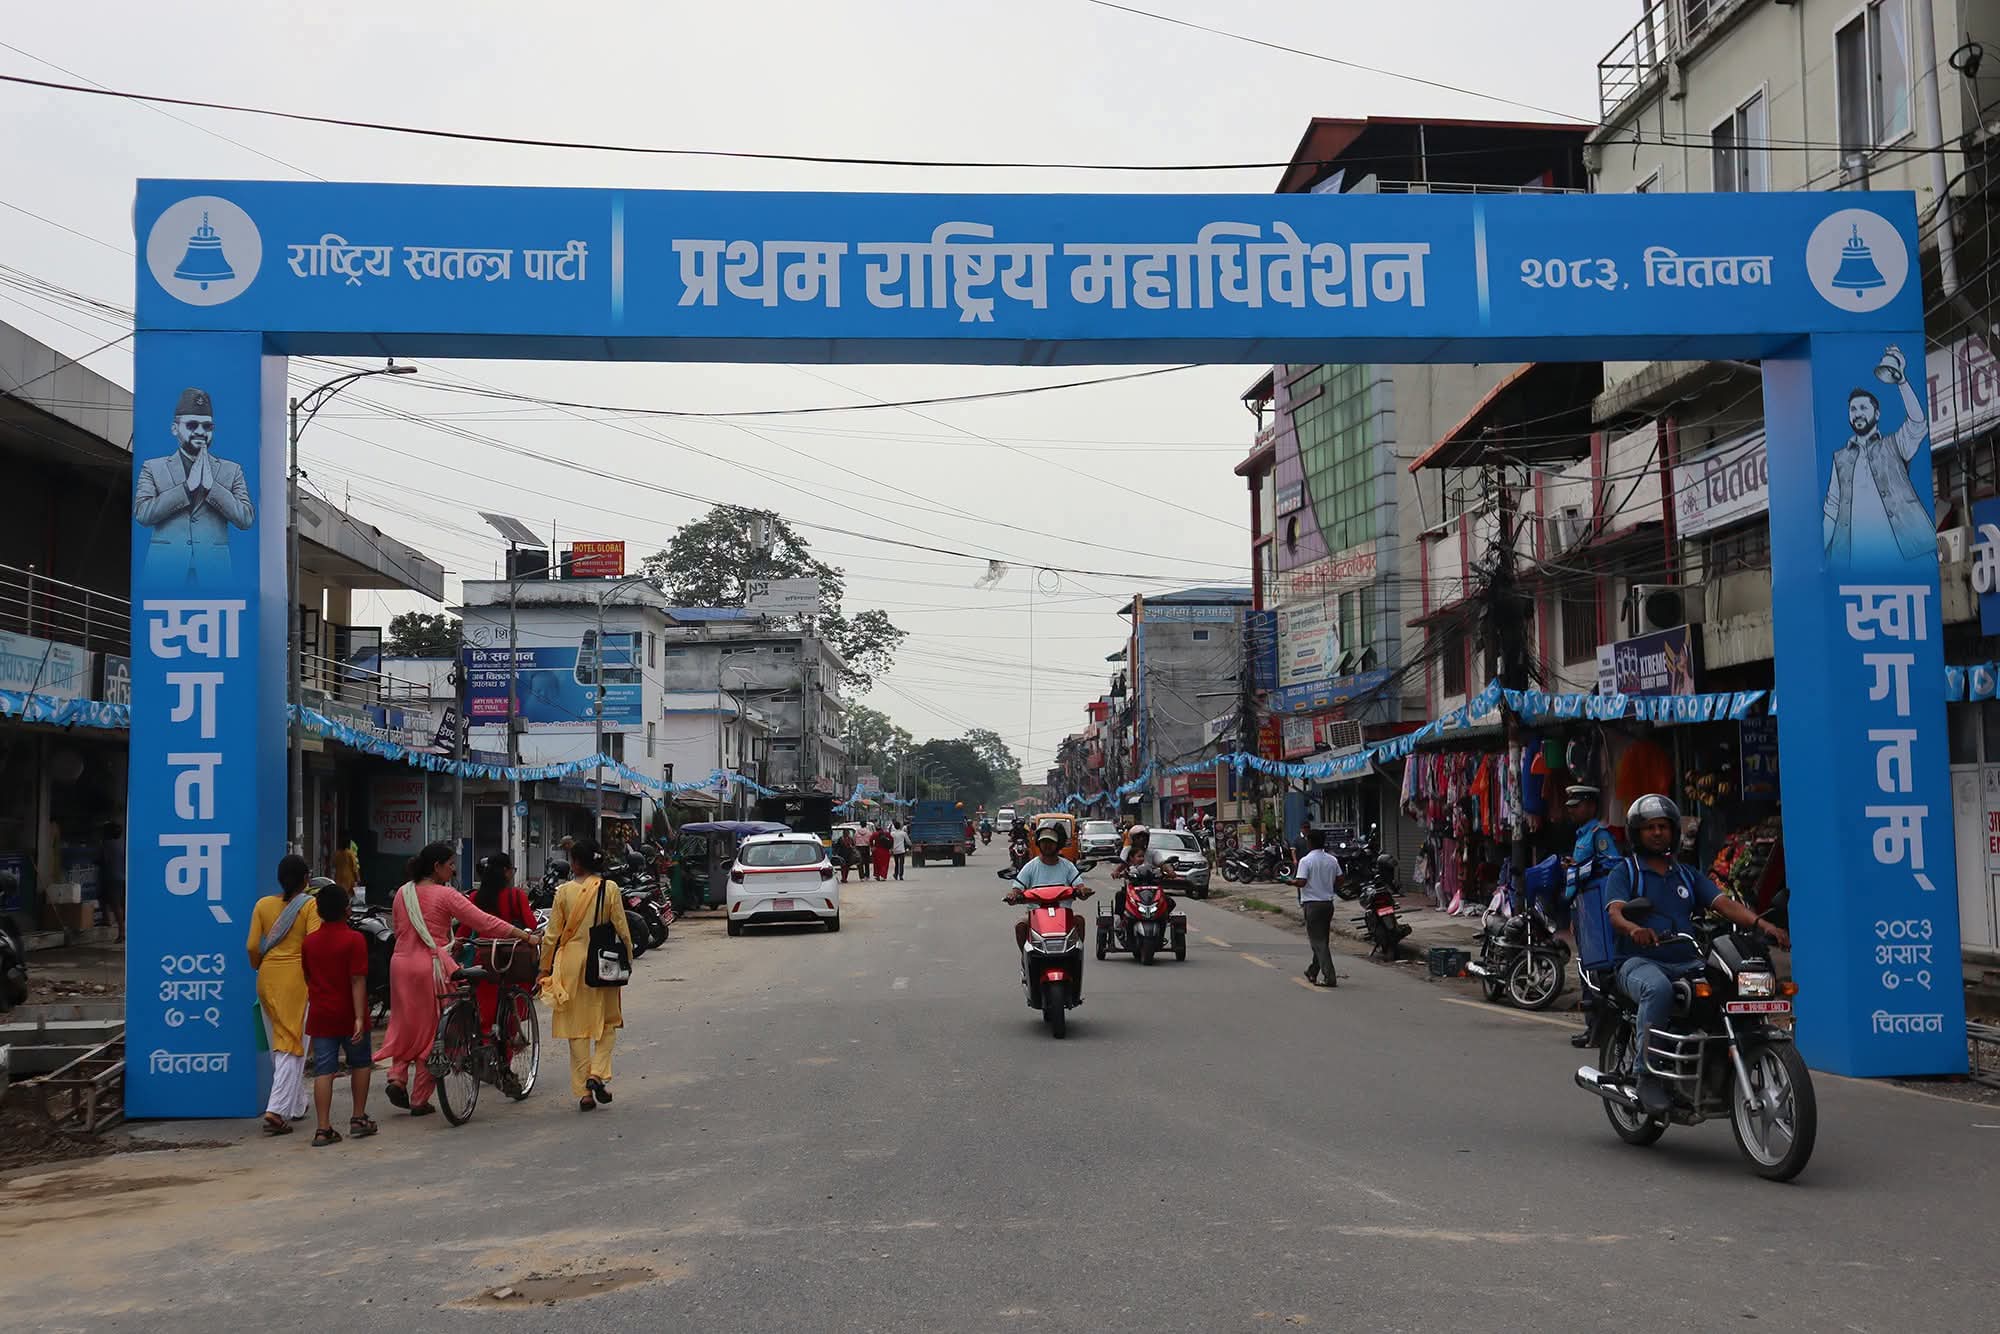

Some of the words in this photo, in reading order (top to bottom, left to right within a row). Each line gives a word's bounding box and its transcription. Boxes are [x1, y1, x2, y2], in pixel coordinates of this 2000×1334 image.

[287, 233, 394, 287] राष्ट्रिय
[402, 246, 513, 282] स्वतन्त्र
[523, 239, 589, 281] पार्टी
[671, 239, 848, 308] प्रथम
[857, 221, 1054, 322] राष्ट्रिय
[1063, 221, 1431, 310] महाधिवेशन
[1642, 246, 1774, 288] चितवन
[574, 543, 595, 553] HOTEL
[597, 543, 623, 553] GLOBAL
[1640, 652, 1668, 677] XTREME
[1875, 919, 1933, 940] २०८३
[161, 953, 226, 975] २०८३
[1875, 945, 1933, 965] असार
[159, 980, 224, 1001] असार
[1872, 1009, 1945, 1034] चितवन
[149, 1049, 231, 1074] चितवन
